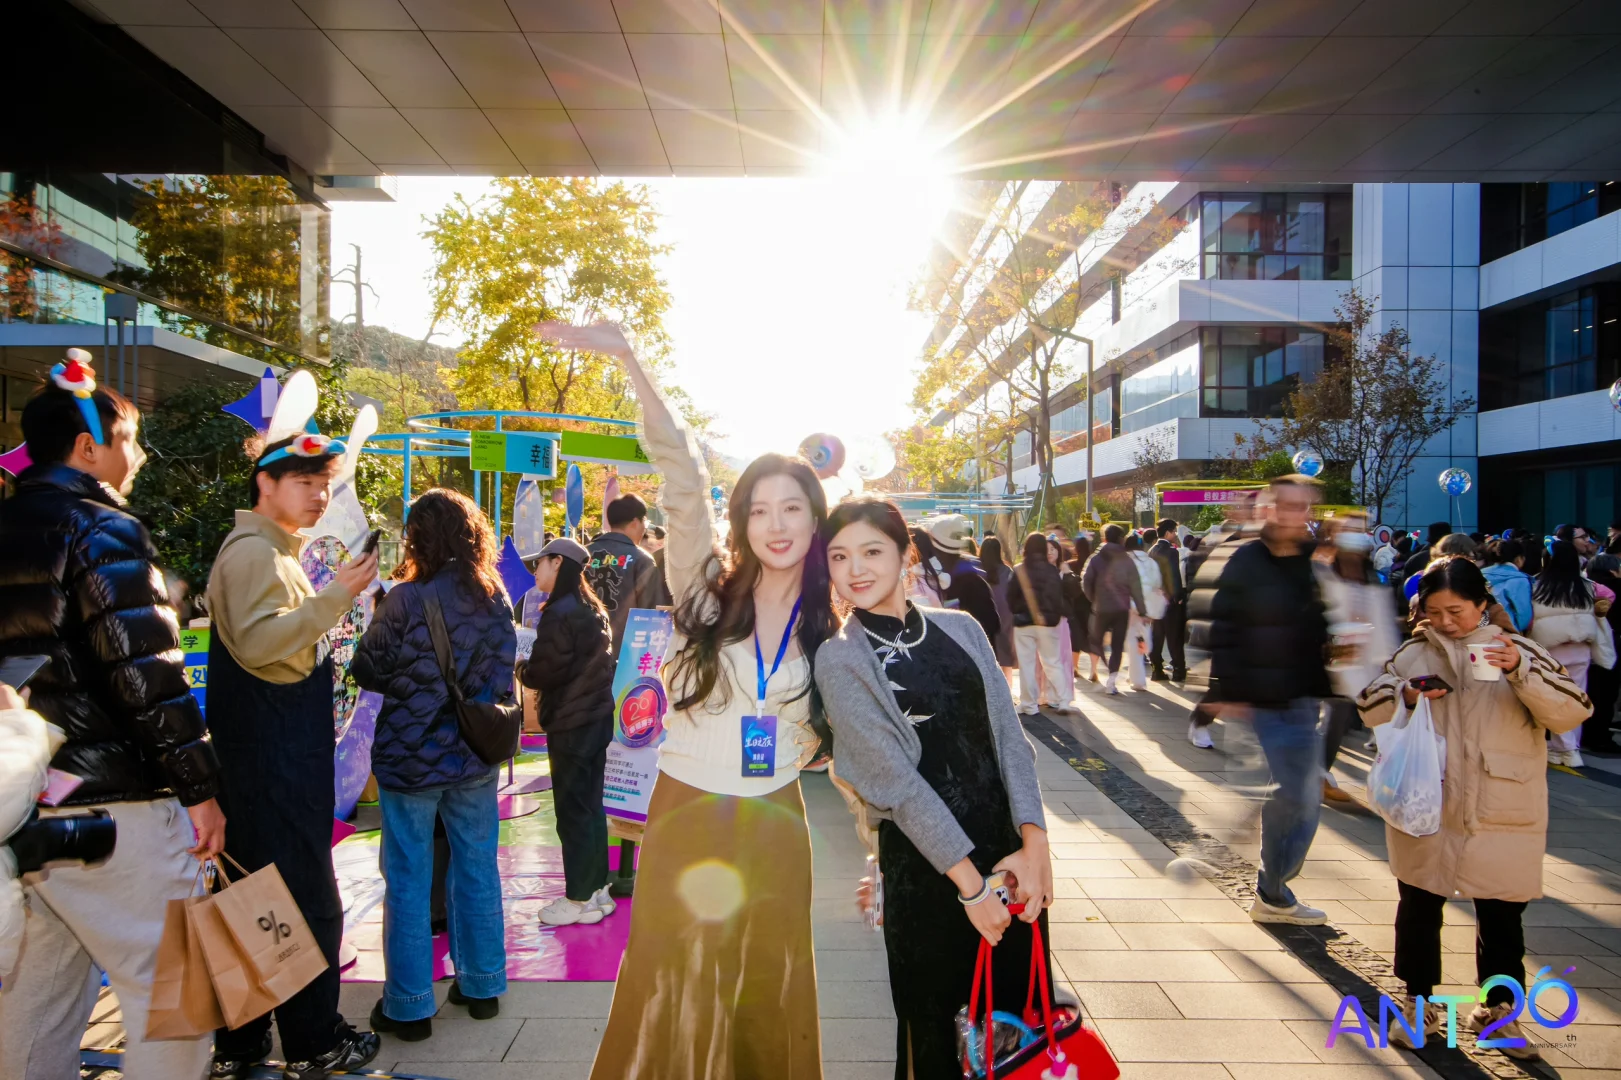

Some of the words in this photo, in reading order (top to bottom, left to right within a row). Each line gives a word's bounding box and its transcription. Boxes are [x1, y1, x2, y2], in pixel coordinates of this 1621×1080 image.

[629, 697, 650, 721] 20
[744, 735, 773, 748] 生日之夜
